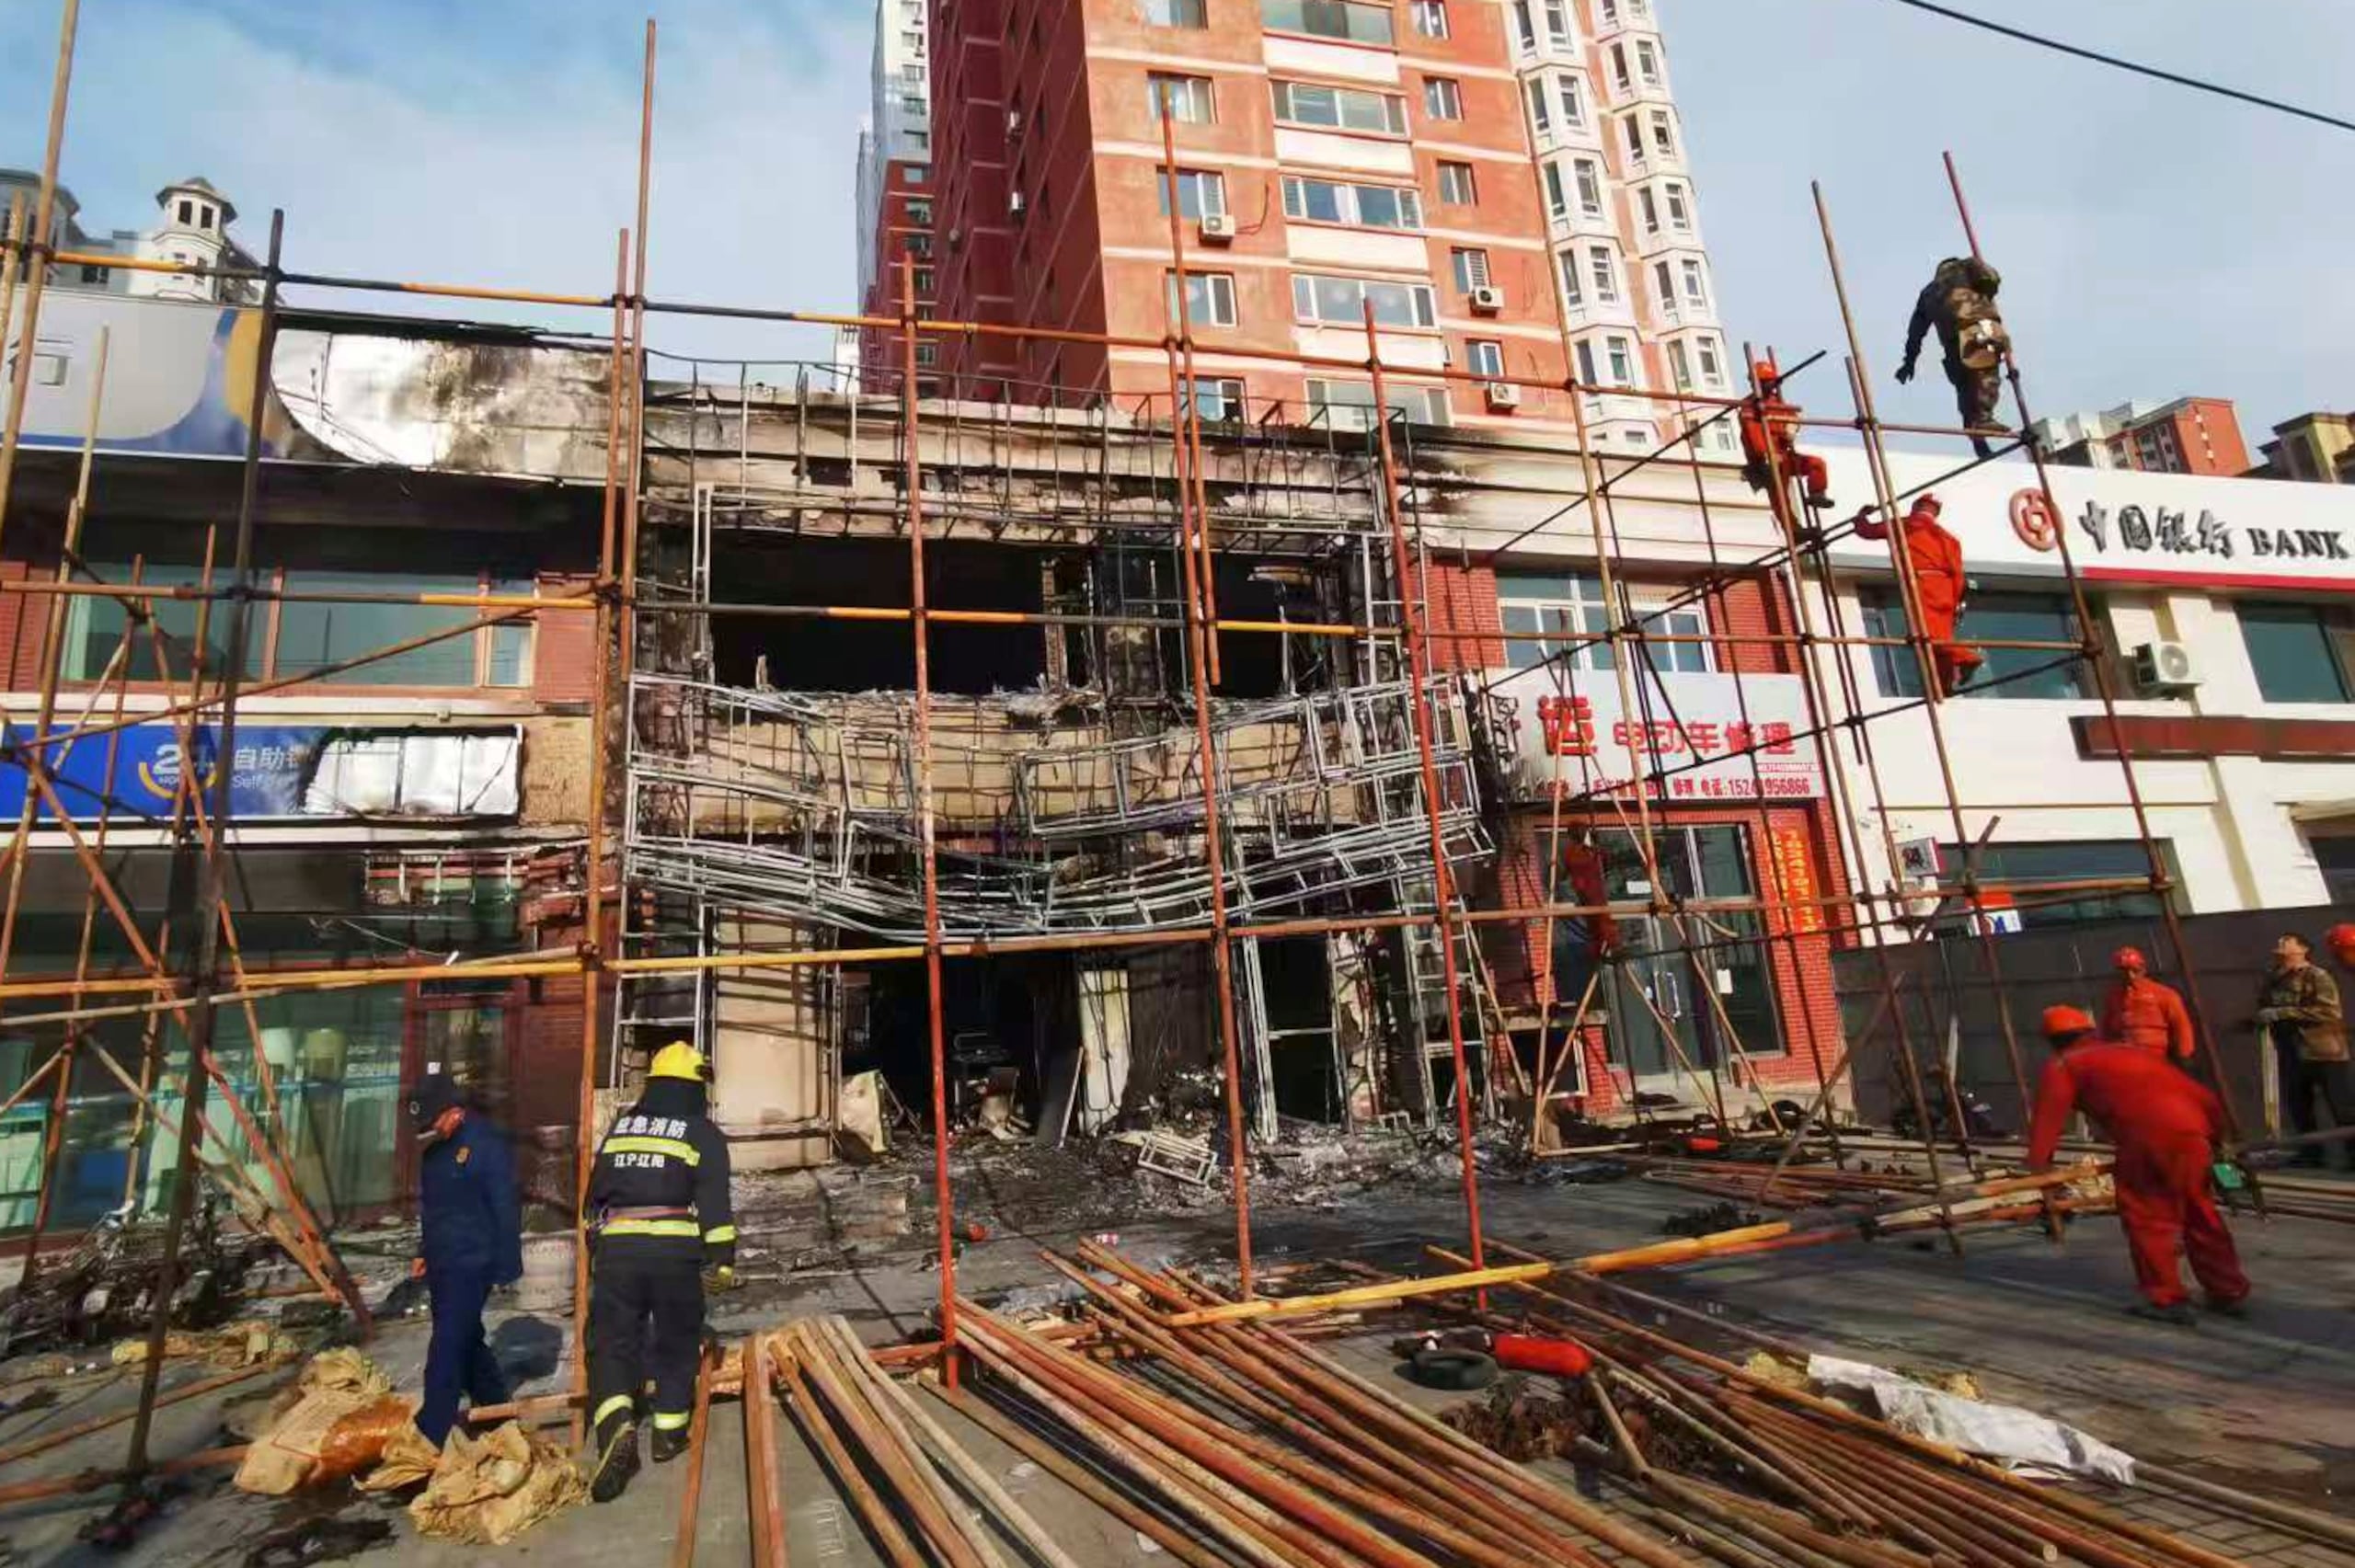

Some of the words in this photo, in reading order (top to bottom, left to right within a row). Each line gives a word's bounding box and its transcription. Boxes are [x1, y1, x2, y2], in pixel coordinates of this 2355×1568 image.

[2078, 499, 2234, 559] 中国银行
[2246, 527, 2349, 559] BANK
